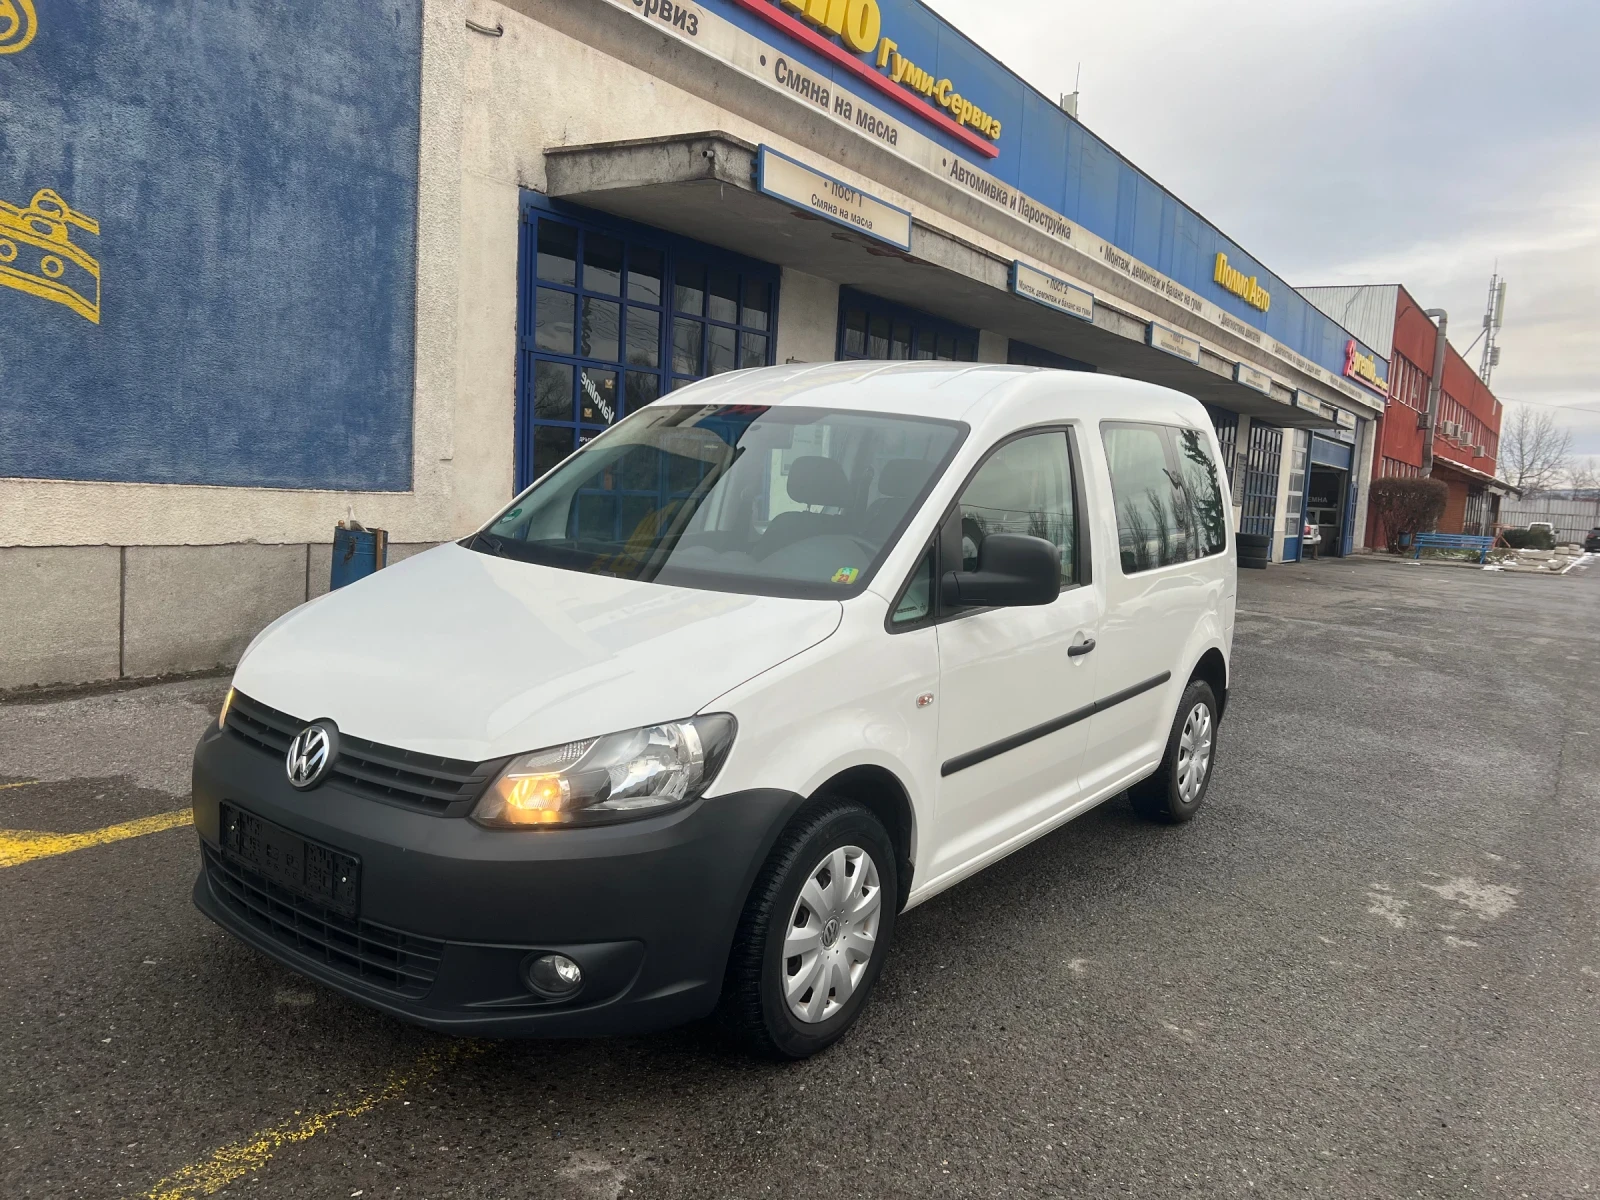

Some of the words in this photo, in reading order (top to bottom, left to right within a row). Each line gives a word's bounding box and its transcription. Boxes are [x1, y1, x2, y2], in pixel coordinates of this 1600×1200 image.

[775, 57, 830, 108] Смяна
[834, 95, 853, 121] на
[856, 108, 898, 146] масла
[876, 37, 1002, 140] Гуми-Сервиз
[811, 193, 838, 215] Смяна
[839, 208, 849, 220] на
[850, 213, 873, 230] масла
[831, 181, 856, 204] ПОСТ
[949, 159, 1008, 206] Автомивка
[1009, 195, 1017, 211] и
[1018, 196, 1072, 240] Пароструйка
